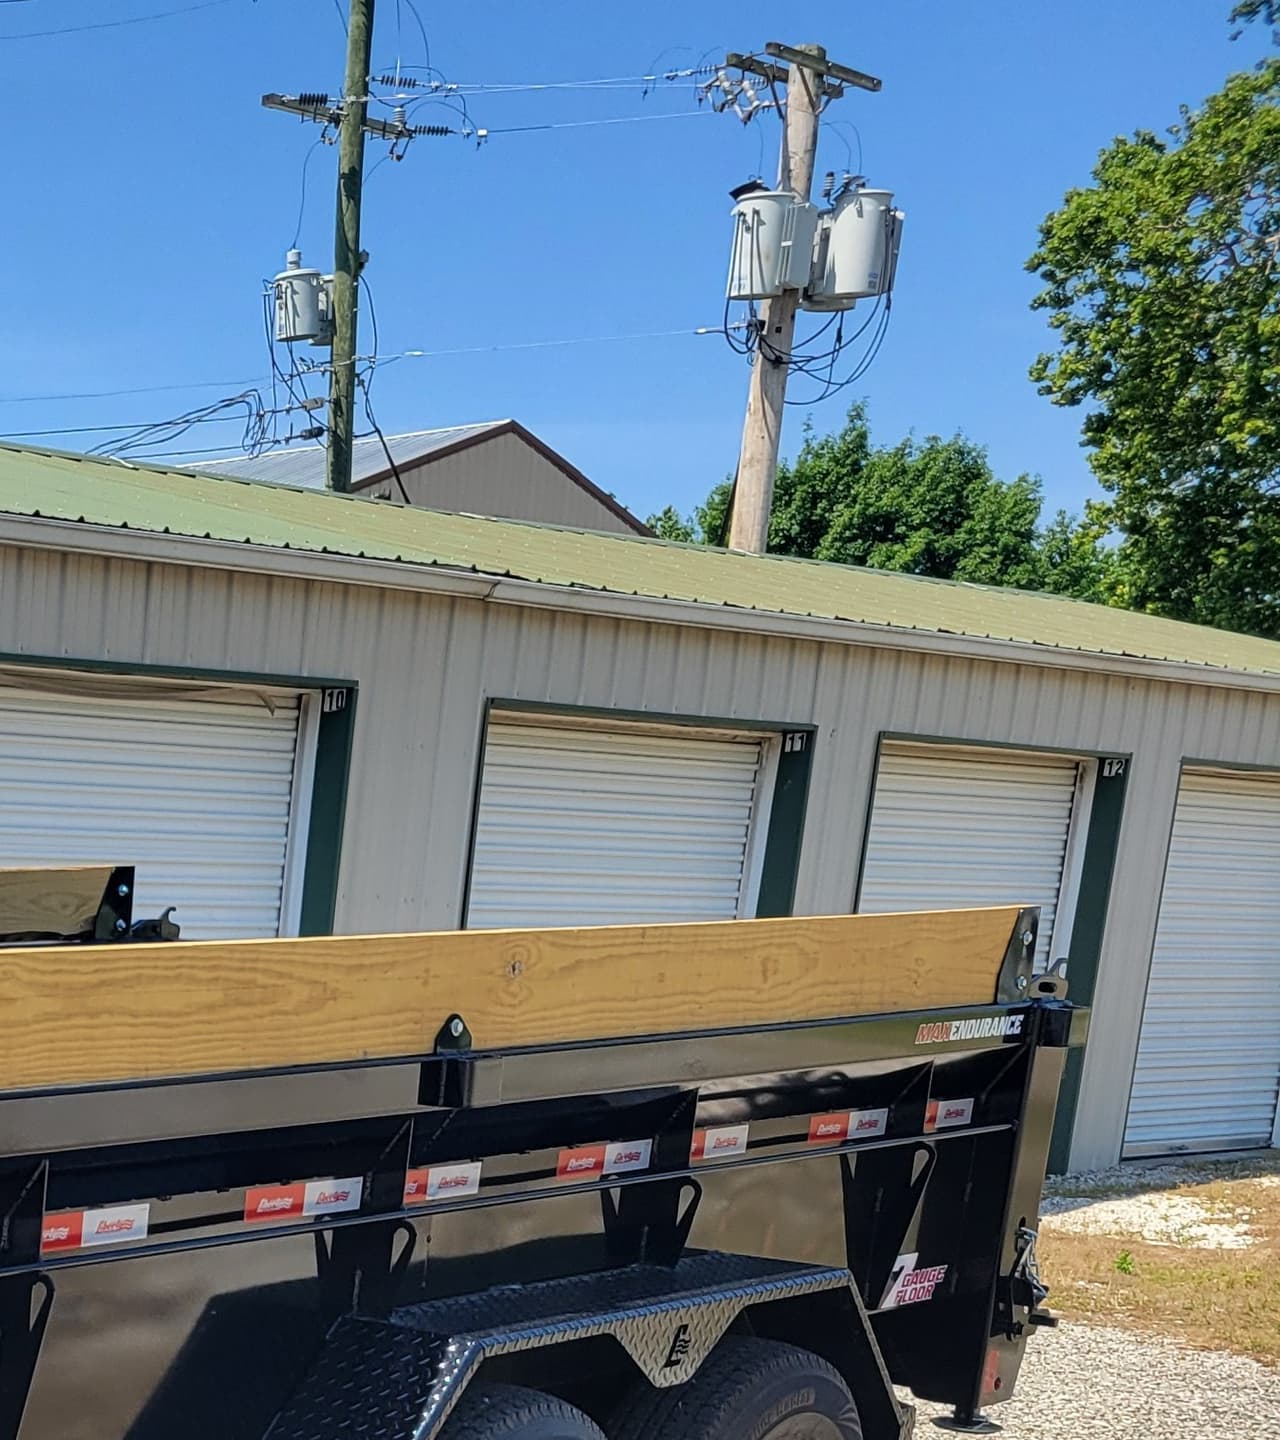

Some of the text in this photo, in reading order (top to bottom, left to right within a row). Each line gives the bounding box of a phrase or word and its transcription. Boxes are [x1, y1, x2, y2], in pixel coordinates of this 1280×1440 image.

[327, 690, 345, 711] 10
[788, 733, 805, 752] 11
[1107, 759, 1123, 776] 12
[881, 1252, 919, 1308] 7
[901, 1265, 947, 1288] GAUGE
[895, 1283, 935, 1304] FLOOR
